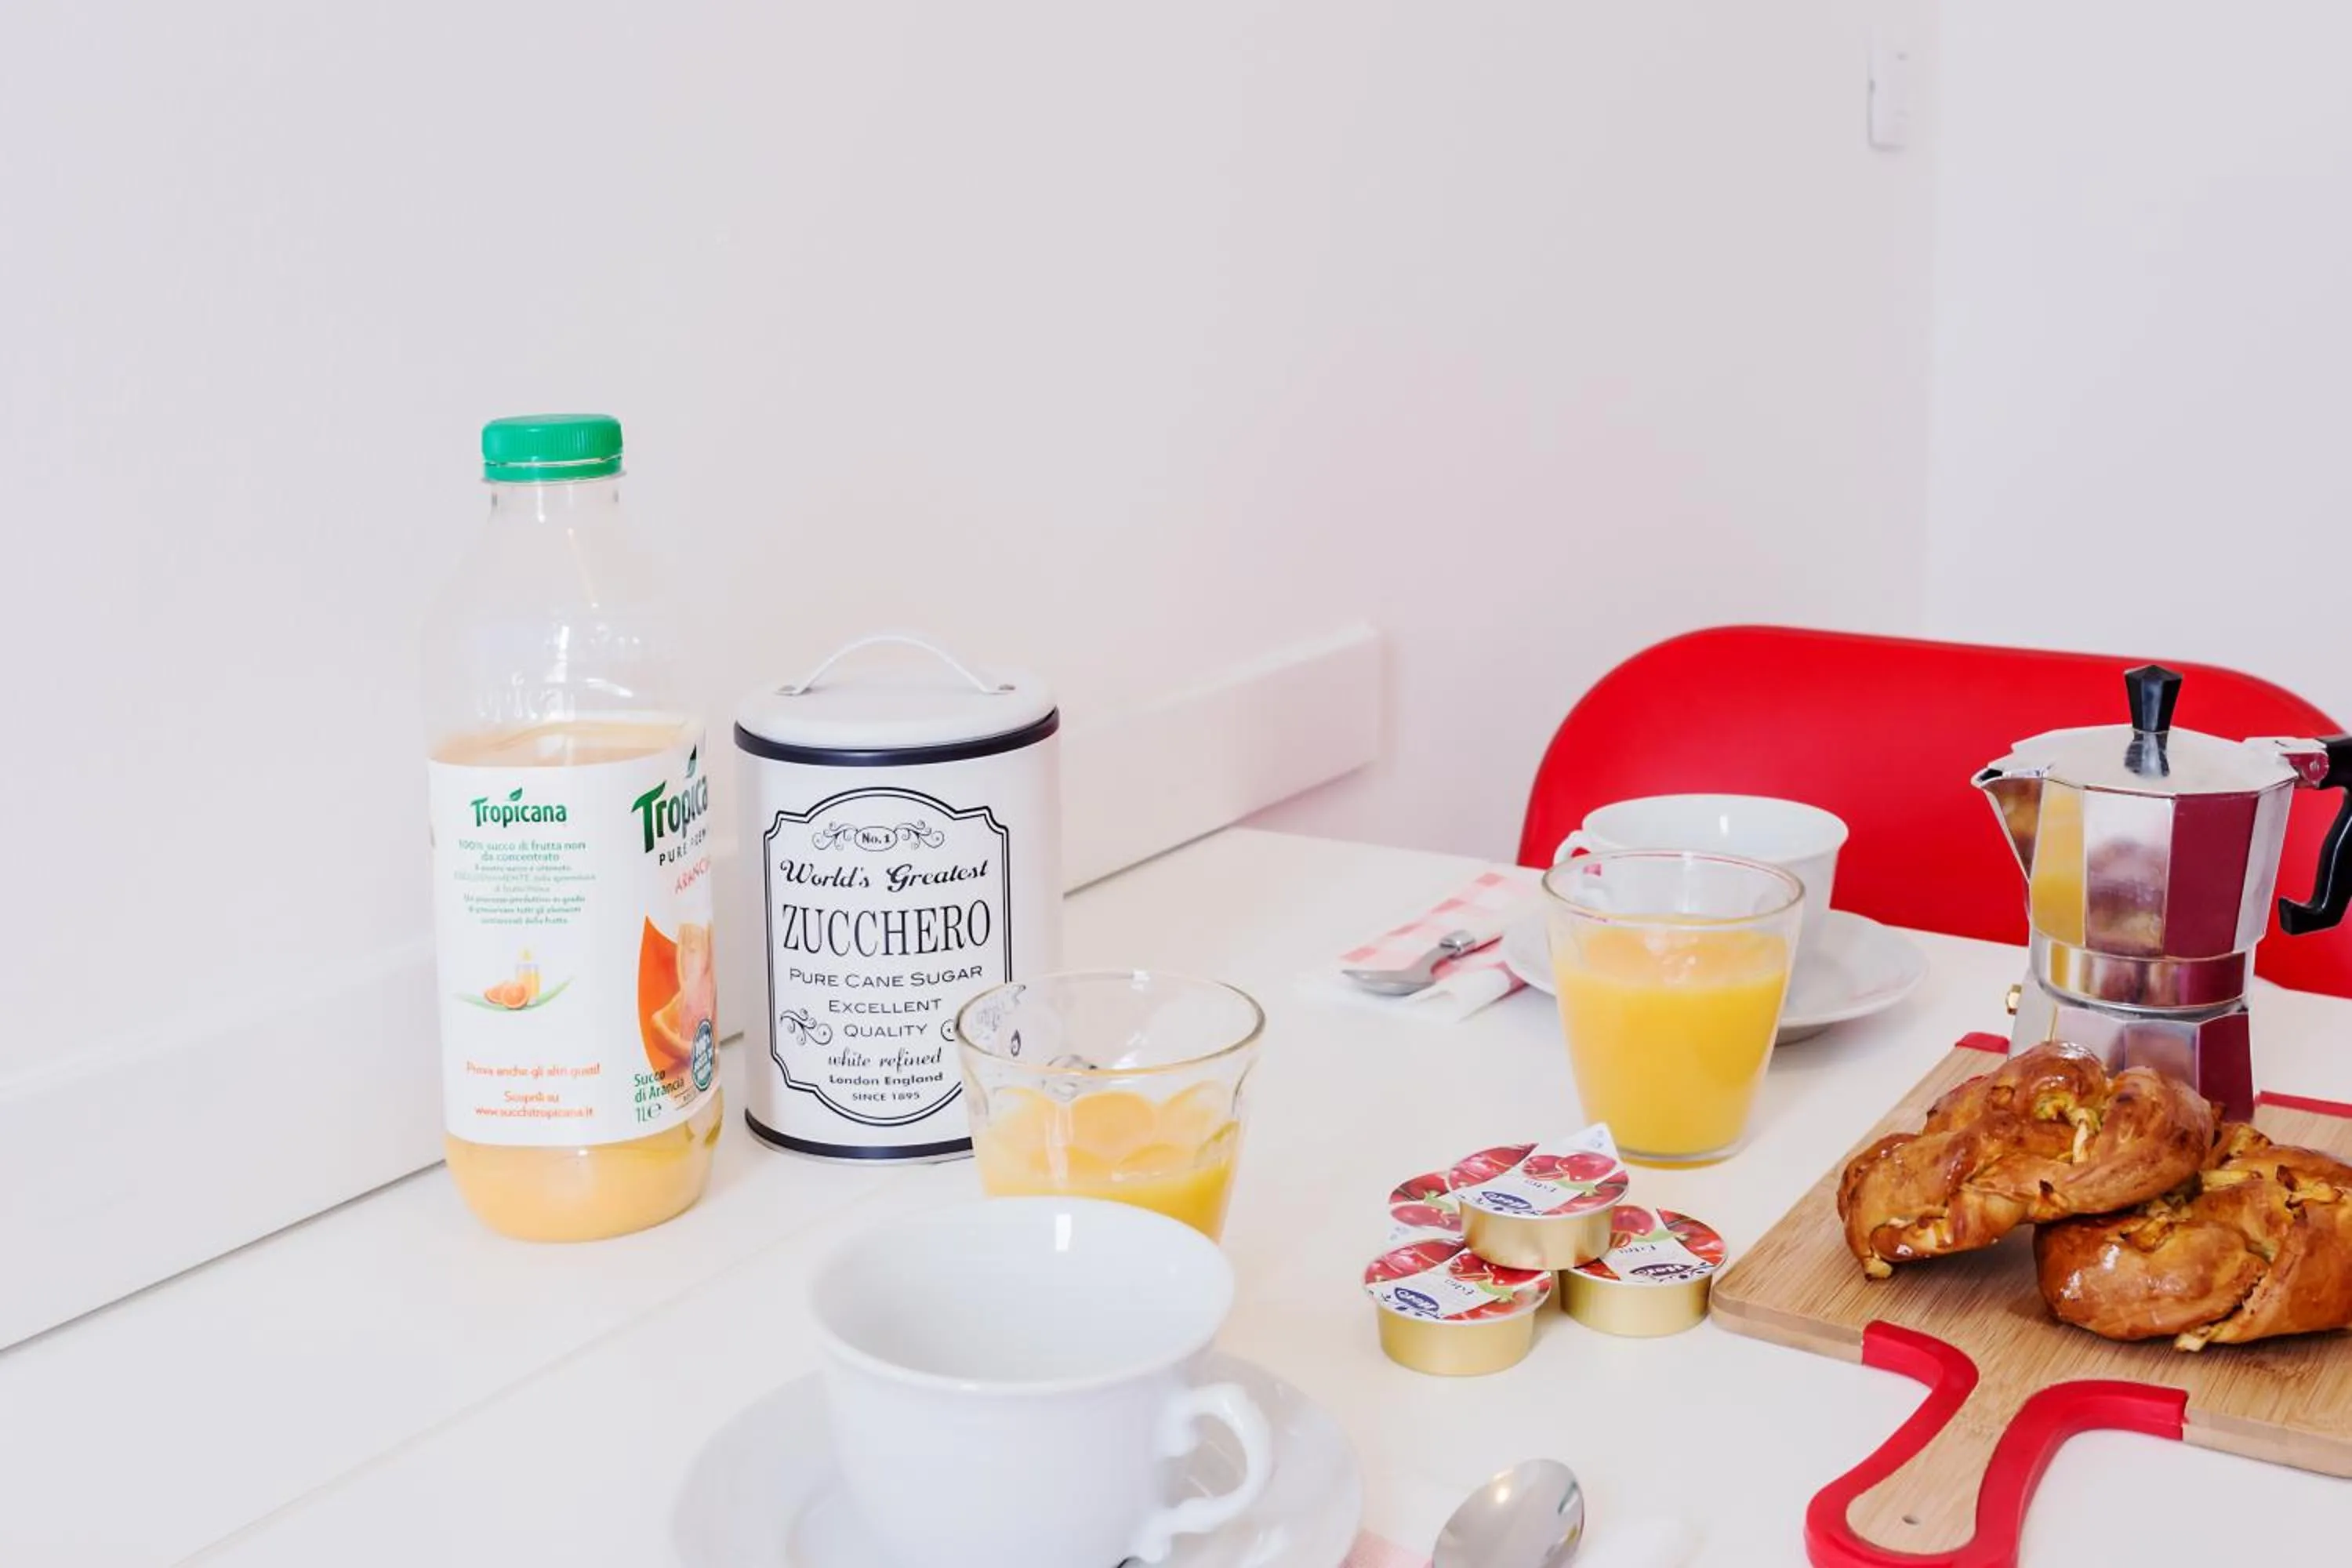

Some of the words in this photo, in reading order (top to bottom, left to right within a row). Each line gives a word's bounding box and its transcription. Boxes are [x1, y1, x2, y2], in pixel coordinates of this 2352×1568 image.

[470, 794, 567, 827] Tropicana
[487, 842, 515, 851] succo
[518, 840, 529, 850] di
[531, 840, 561, 851] frutta
[564, 841, 586, 850] non
[659, 842, 687, 866] PURE
[780, 860, 870, 889] World's
[886, 860, 989, 892] Greatest
[782, 899, 991, 957] ZUCCHERO
[789, 967, 839, 988] PURE
[844, 973, 904, 989] CANE
[909, 965, 984, 986] SUGAR
[828, 999, 942, 1014] EXCELLENT
[844, 1025, 928, 1040] QUALITY
[496, 1065, 528, 1076] anche
[828, 1047, 871, 1067] white
[880, 1047, 942, 1074] refined
[634, 1070, 666, 1087] Succo
[829, 1074, 880, 1086] London
[884, 1073, 943, 1088] England
[634, 1089, 646, 1103] di
[649, 1078, 684, 1099] Arancia
[852, 1091, 887, 1102] SINCE
[891, 1091, 920, 1101] 1895
